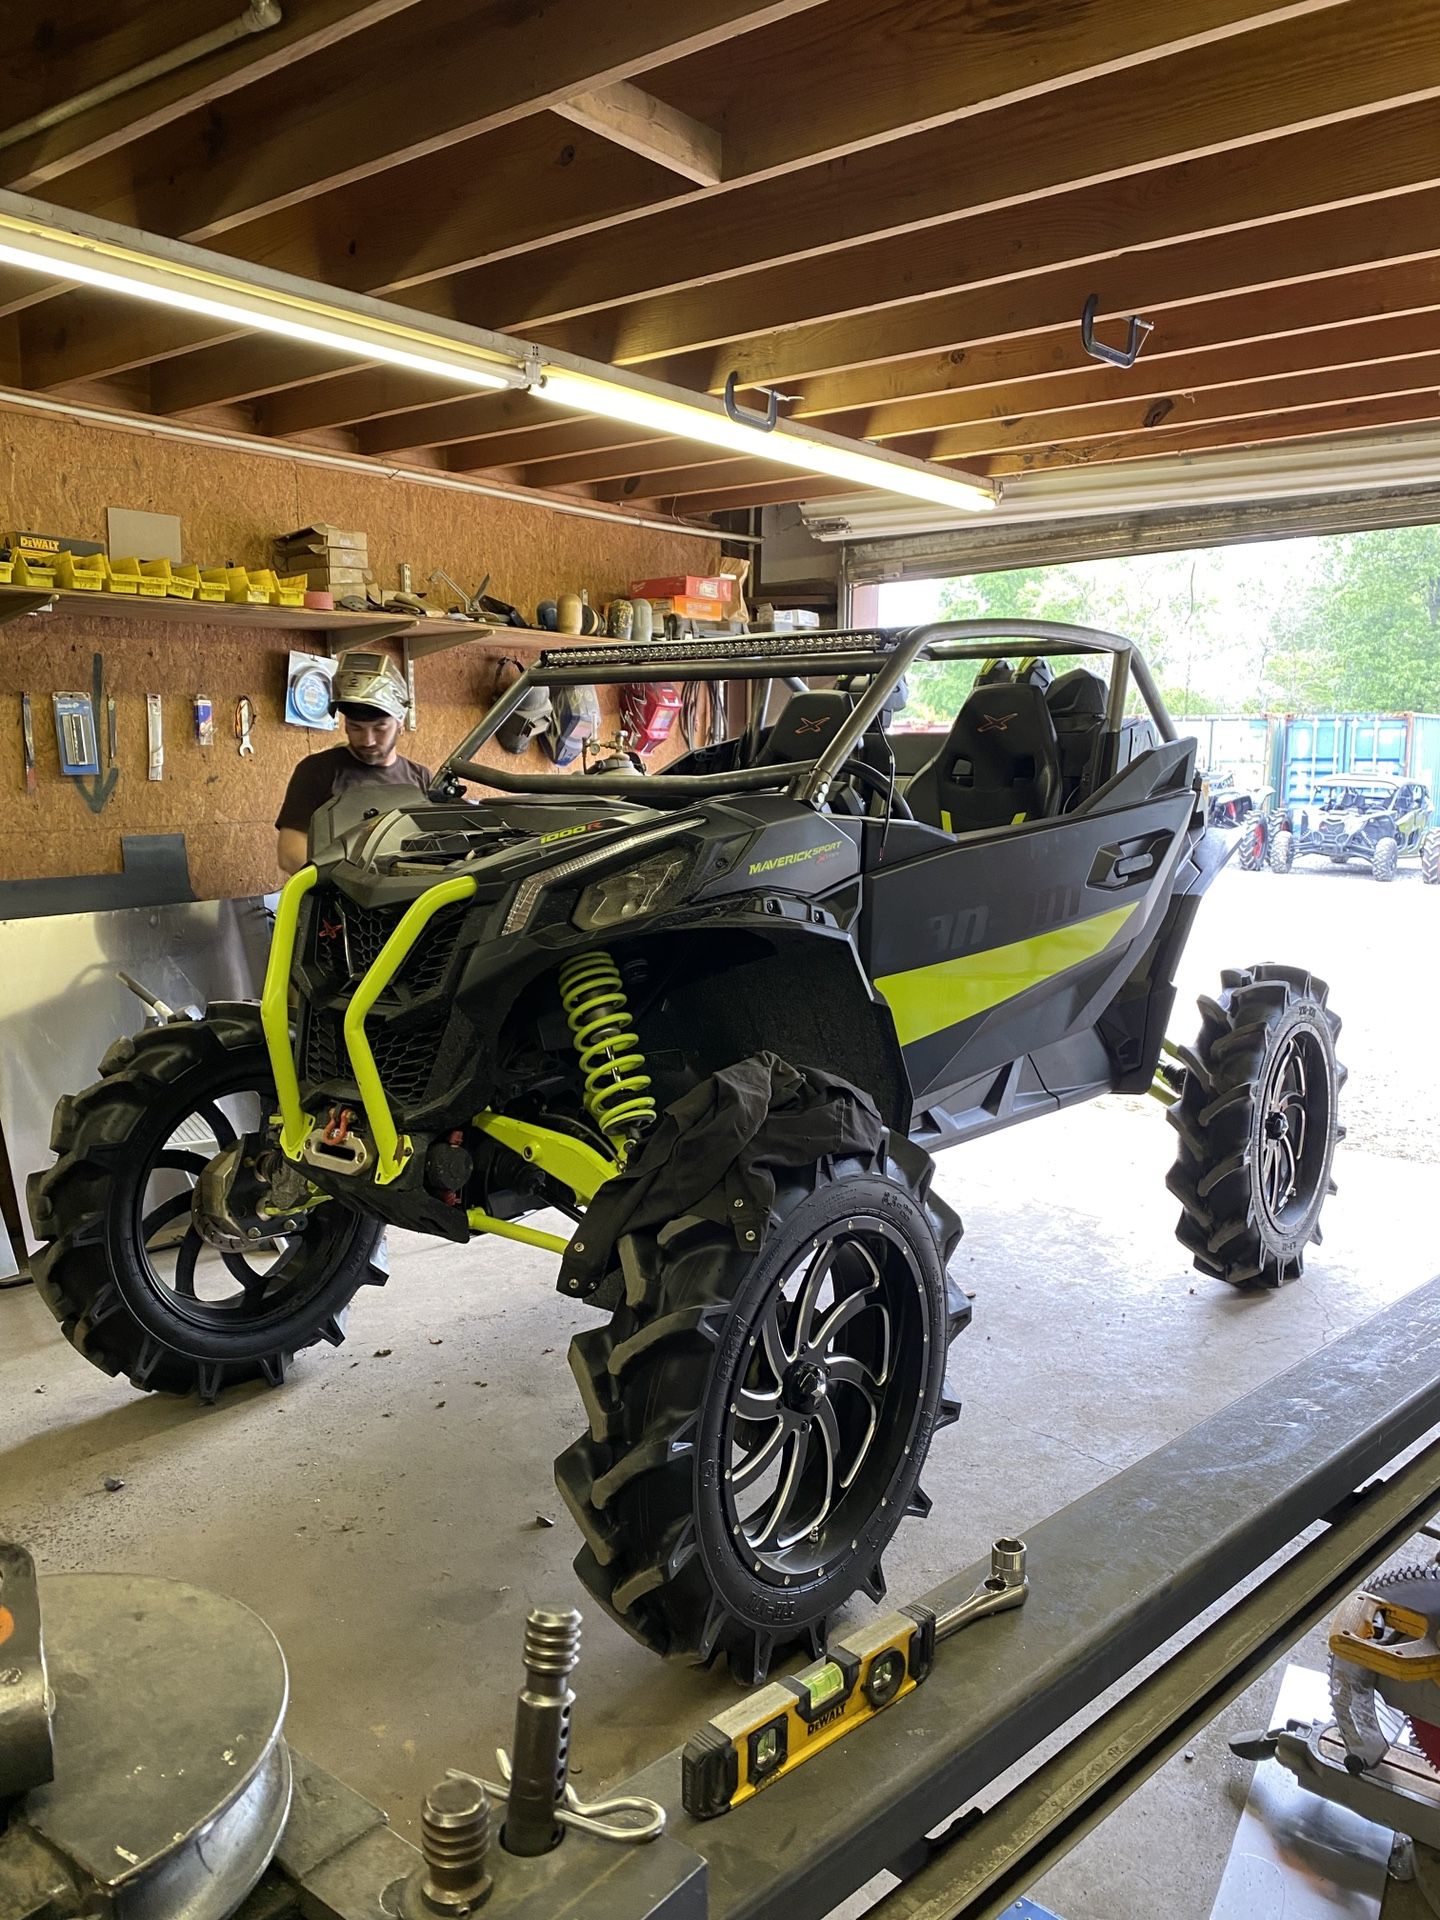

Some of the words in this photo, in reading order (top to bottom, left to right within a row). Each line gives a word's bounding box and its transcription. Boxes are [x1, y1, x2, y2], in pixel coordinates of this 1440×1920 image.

[540, 820, 604, 844] 1000R
[748, 849, 813, 875] MAVERICK
[807, 1702, 846, 1737] DEWALT
